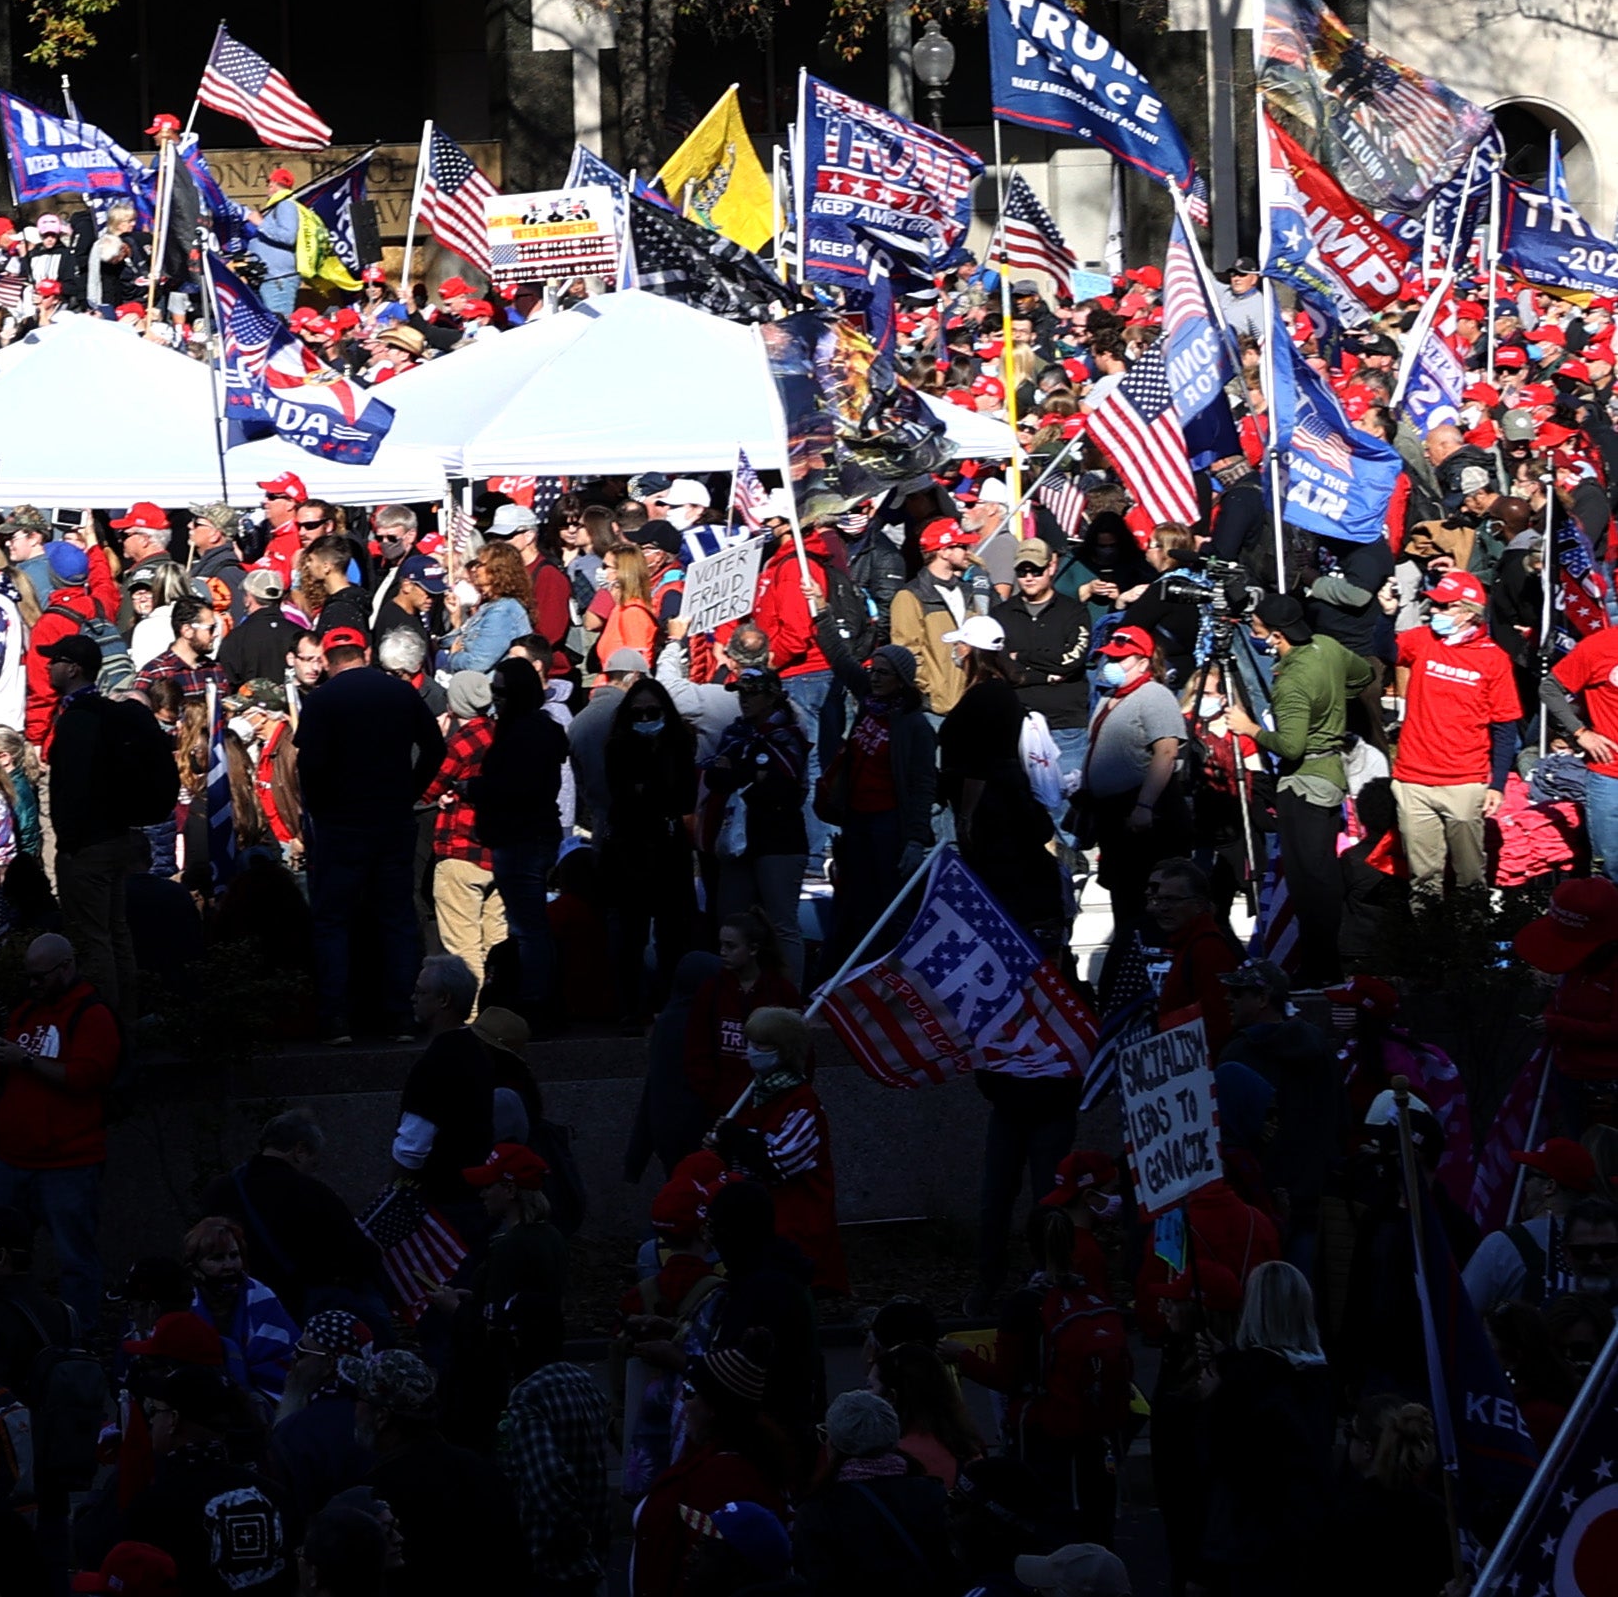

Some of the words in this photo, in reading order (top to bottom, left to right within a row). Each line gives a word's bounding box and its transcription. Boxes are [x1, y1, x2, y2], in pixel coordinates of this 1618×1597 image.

[1016, 39, 1162, 124] PENCE
[1342, 122, 1388, 183] TRUMP
[811, 199, 855, 216] KEEP
[810, 238, 853, 259] KEEP
[1323, 473, 1350, 492] THE
[694, 549, 749, 584] VOTER
[689, 573, 744, 611] FRAUD
[1426, 659, 1482, 681] TRUMP
[1175, 1087, 1198, 1123] TO
